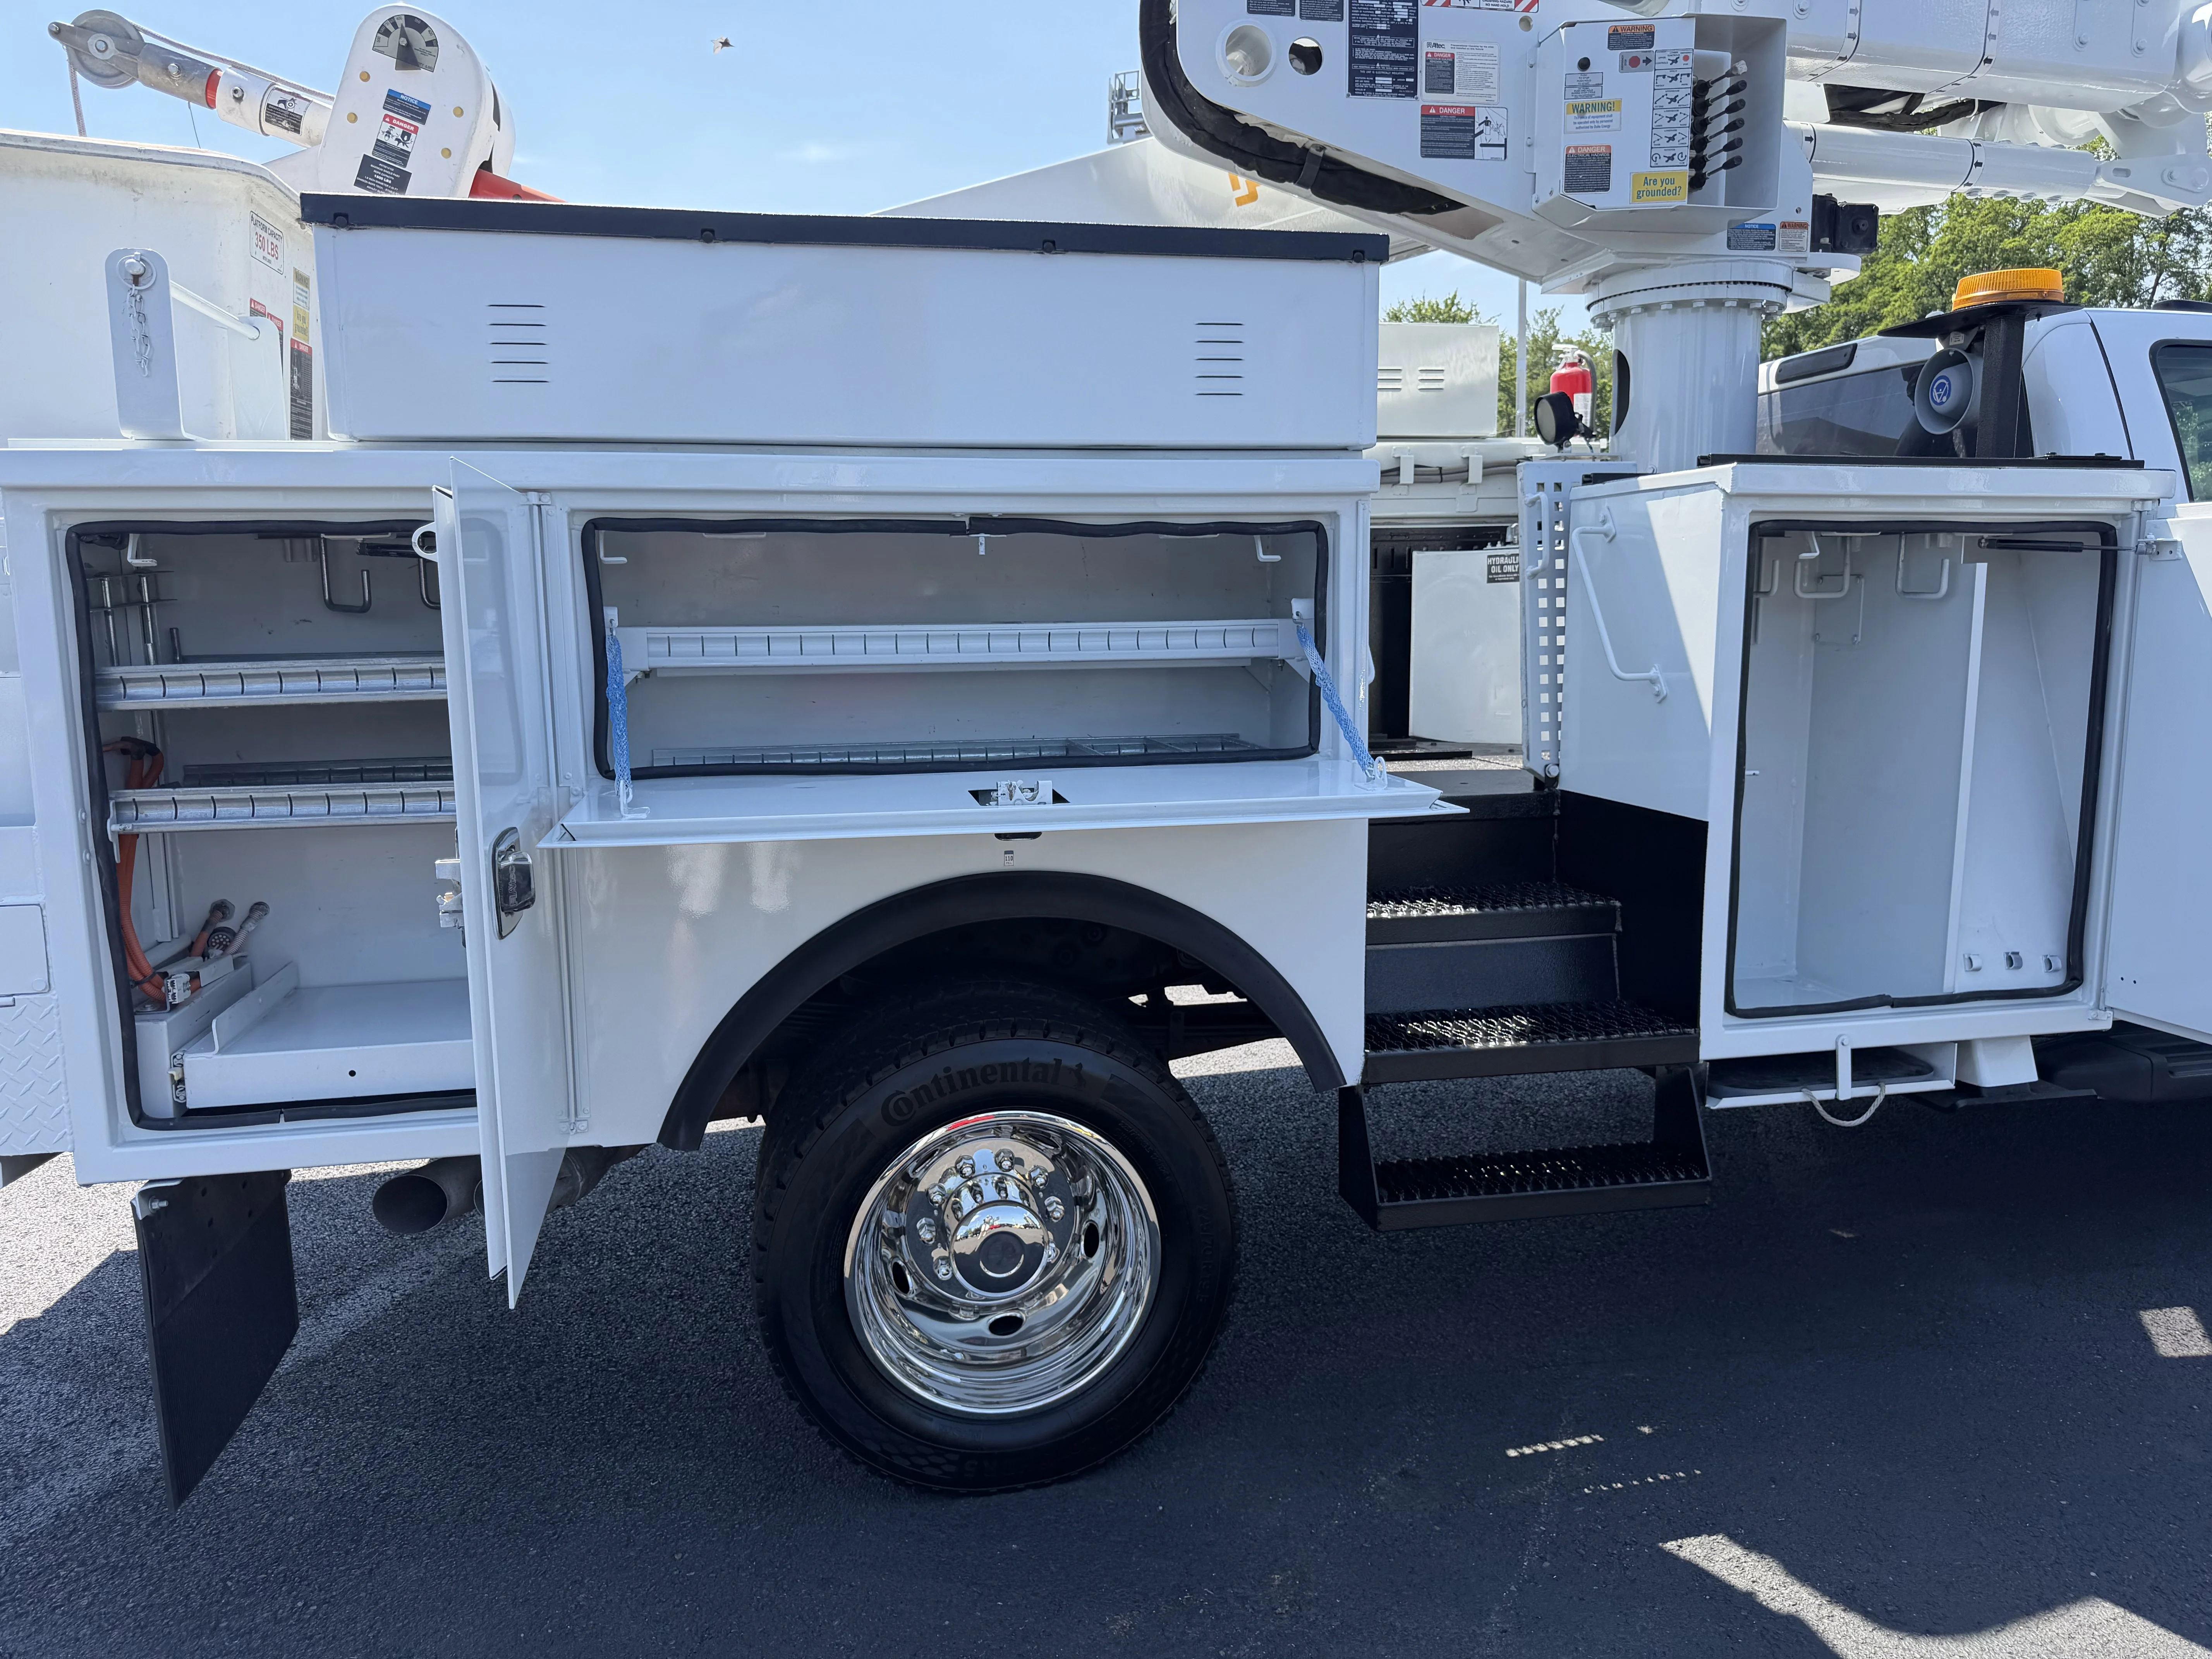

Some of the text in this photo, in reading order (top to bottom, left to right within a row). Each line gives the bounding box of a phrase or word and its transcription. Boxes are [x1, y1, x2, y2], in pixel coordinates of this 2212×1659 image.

[400, 94, 419, 105] NOTICE
[1572, 102, 1615, 113] WARNING!
[393, 119, 414, 131] DANGER
[1643, 177, 1675, 188] Are you
[1636, 185, 1682, 199] grounded?
[251, 214, 282, 244] PLATFORM CAPACITY
[255, 232, 279, 261] 350 LBS
[255, 302, 265, 313] DANGER
[1487, 556, 1519, 565] HYDRAULI
[1491, 564, 1519, 573] OIL ONLY
[881, 1057, 1062, 1127] Continental
